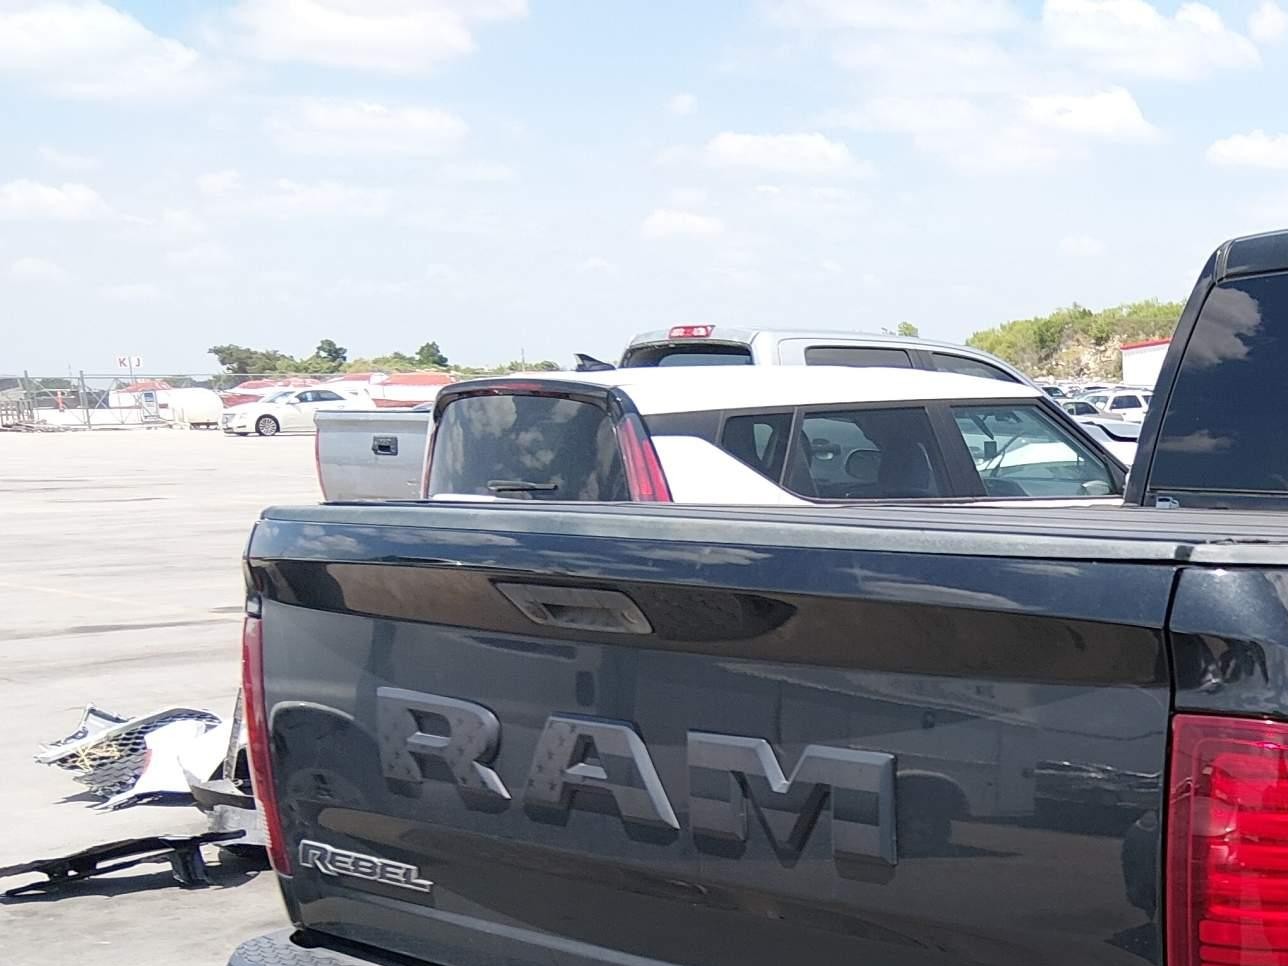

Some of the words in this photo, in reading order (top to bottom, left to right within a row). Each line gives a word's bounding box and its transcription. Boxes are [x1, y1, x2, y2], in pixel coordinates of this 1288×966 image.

[118, 357, 128, 368] K
[376, 685, 897, 866] RAM
[298, 839, 434, 893] REBEL
